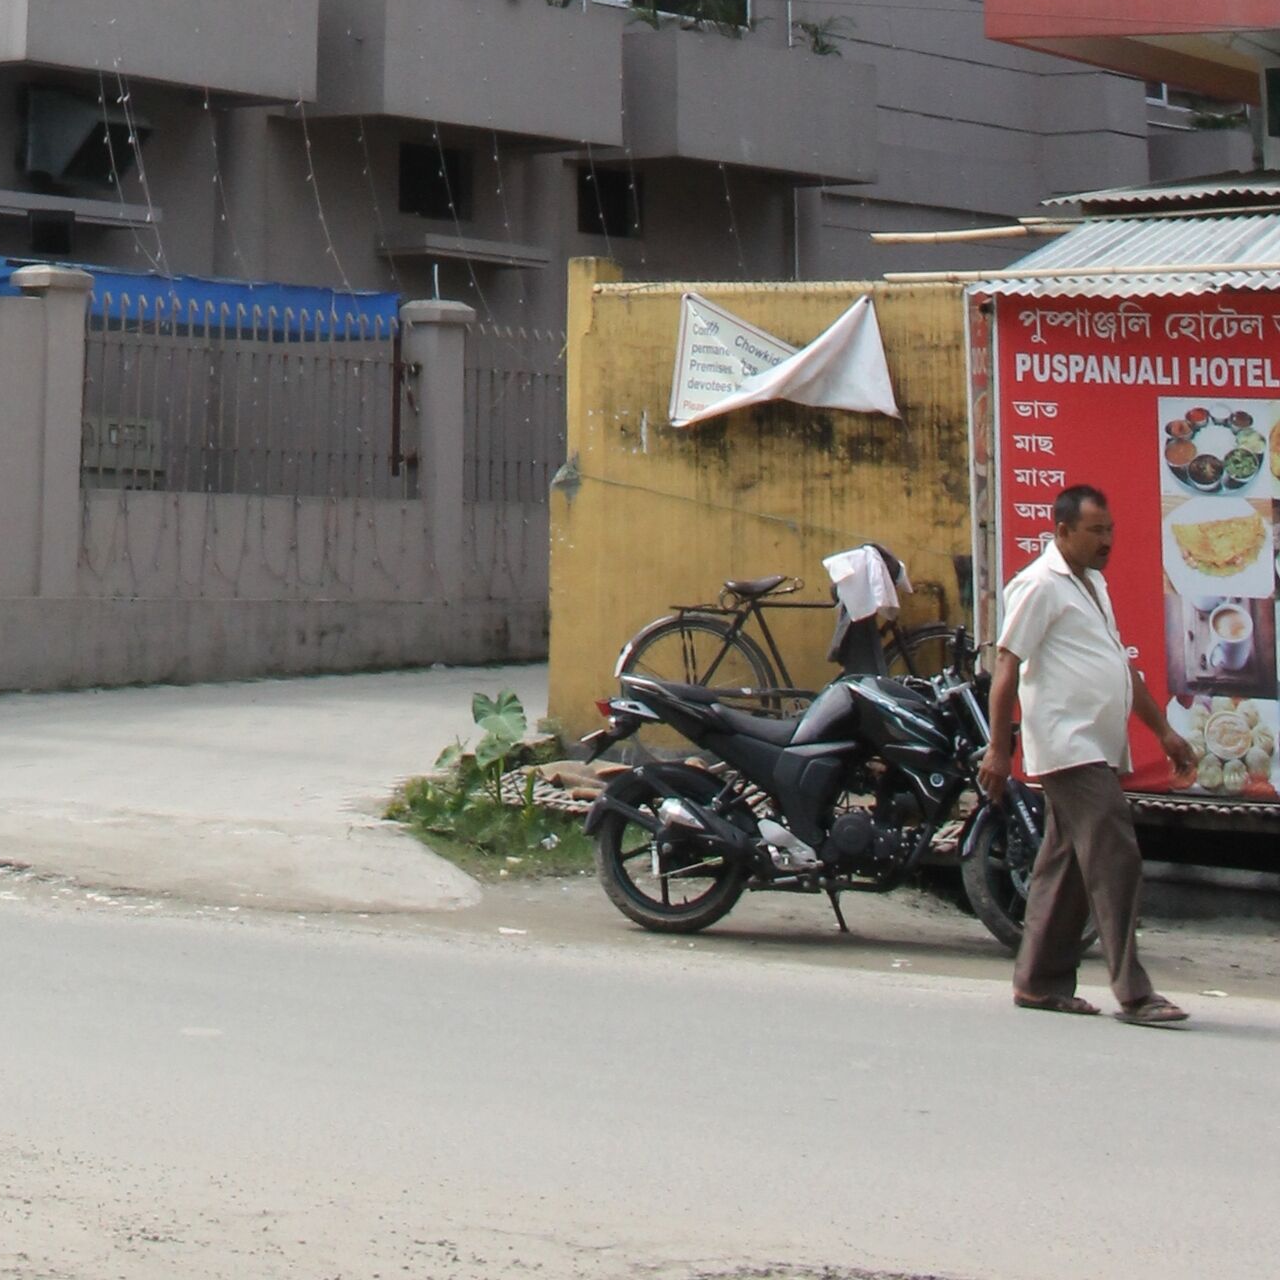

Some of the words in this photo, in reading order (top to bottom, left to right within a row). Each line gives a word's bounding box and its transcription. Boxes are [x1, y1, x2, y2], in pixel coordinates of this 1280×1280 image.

[1165, 304, 1264, 342] হোটেল
[1015, 352, 1180, 386] PUSPANJALI
[1189, 356, 1280, 388] HOTEL
[687, 378, 732, 392] devotees
[1012, 400, 1059, 419] ভাত
[1012, 434, 1056, 455] মাছ
[1013, 468, 1066, 488] মাংস
